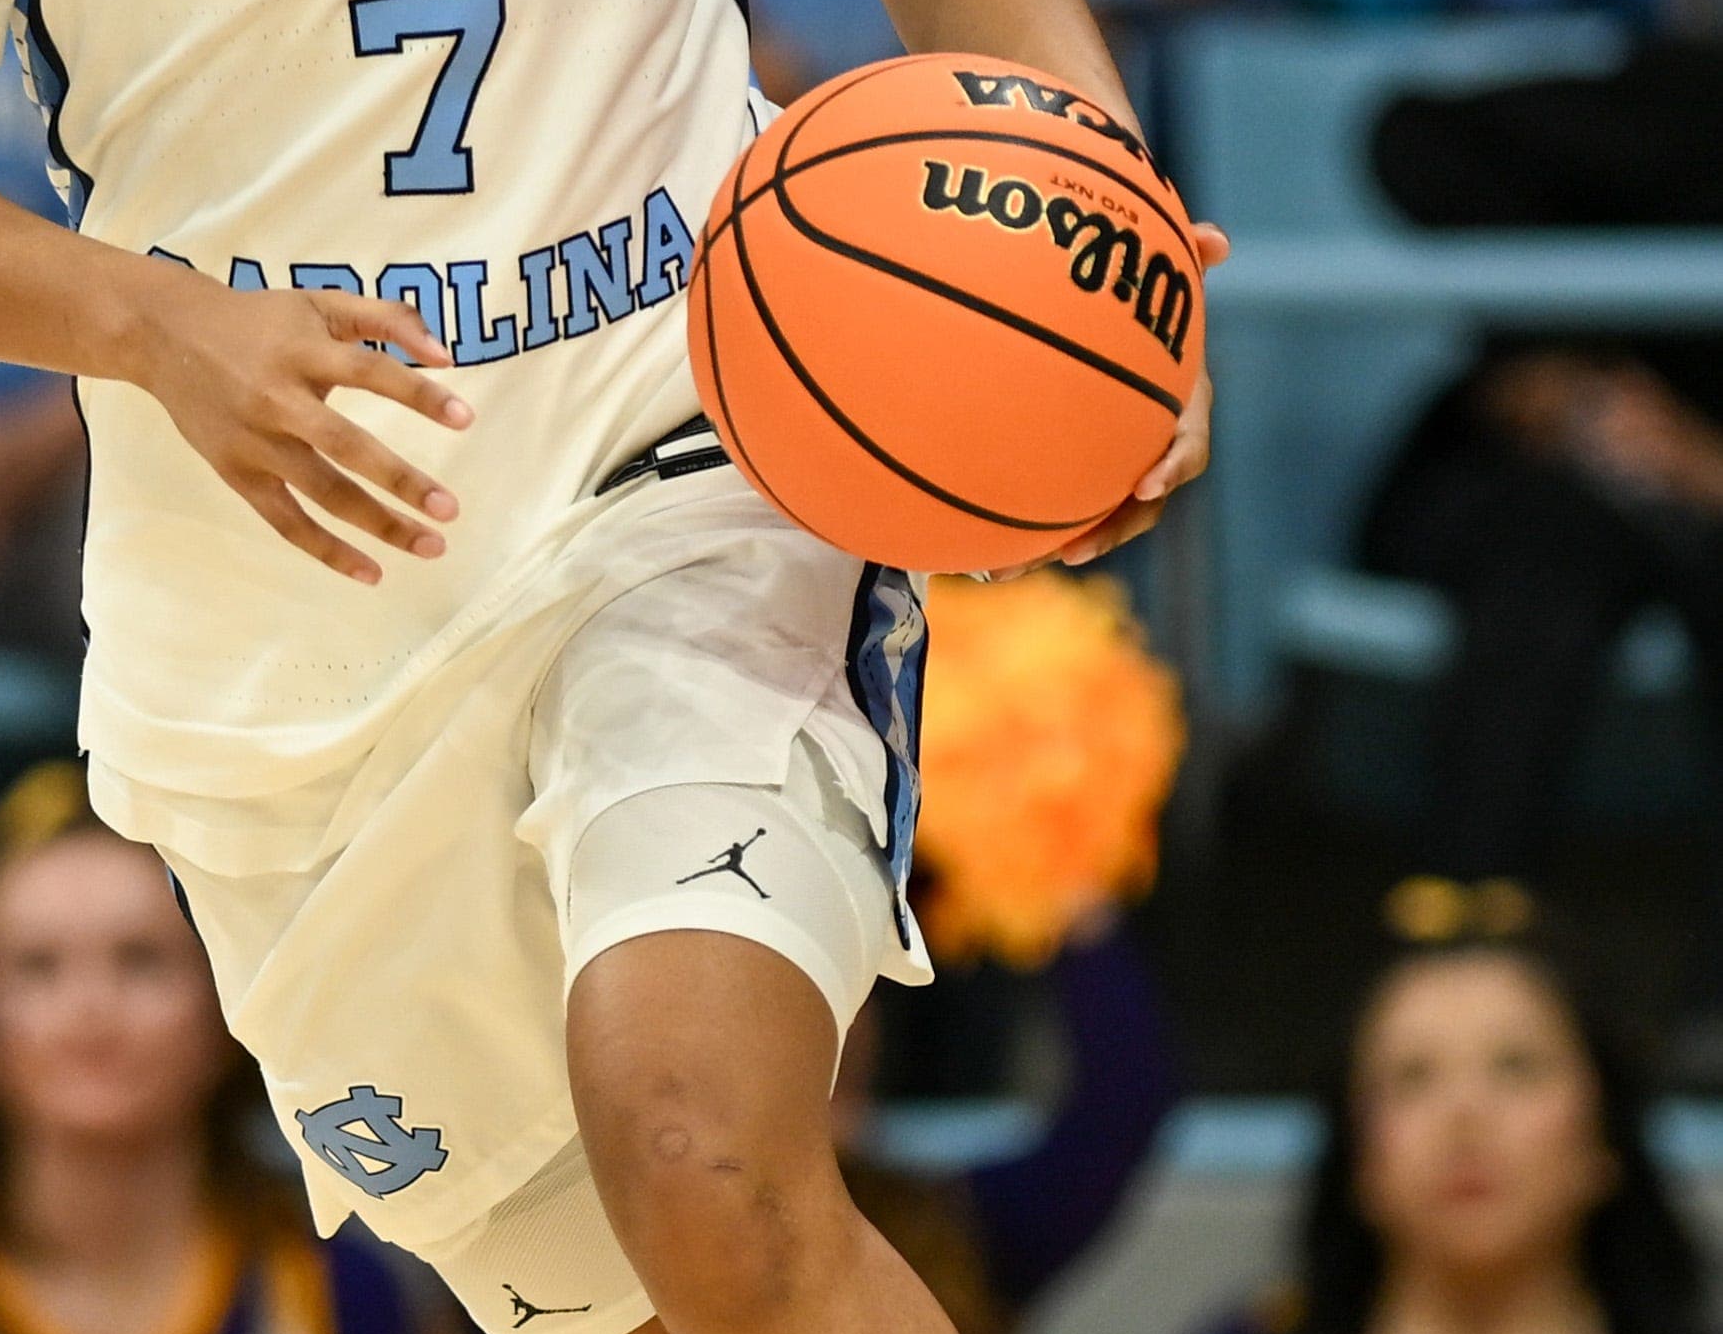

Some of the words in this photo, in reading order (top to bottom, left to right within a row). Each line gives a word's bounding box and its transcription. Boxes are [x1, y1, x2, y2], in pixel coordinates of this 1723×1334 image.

[952, 71, 1172, 192] CAA
[1050, 175, 1094, 200] NXT
[922, 160, 1193, 365] Wilson
[1100, 195, 1138, 225] EVO
[147, 186, 695, 367] OLINA
